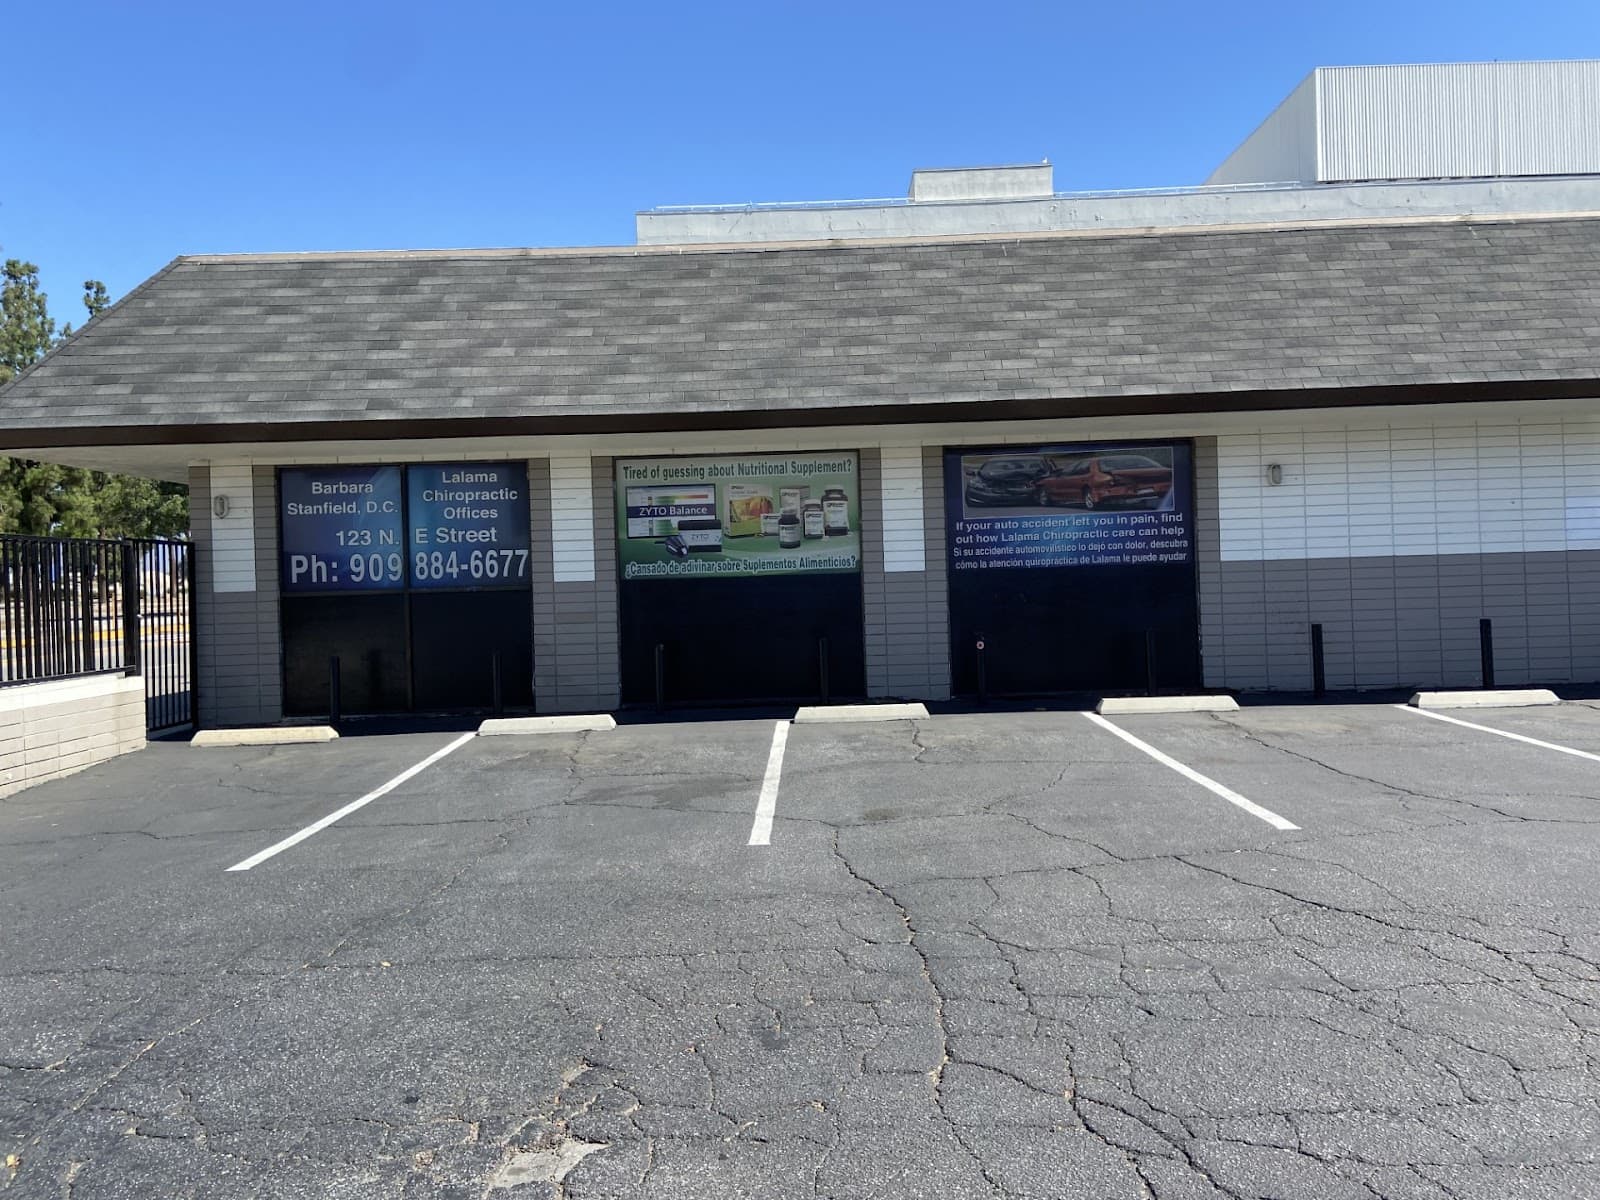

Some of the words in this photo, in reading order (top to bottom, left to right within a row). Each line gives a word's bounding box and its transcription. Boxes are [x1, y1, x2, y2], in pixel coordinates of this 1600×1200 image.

[442, 471, 497, 483] Lalama
[623, 465, 647, 479] Tired
[650, 465, 660, 478] of
[663, 464, 705, 480] guessing
[708, 464, 734, 476] about
[737, 461, 788, 476] Nutritional
[791, 459, 852, 476] Supplement?
[312, 481, 374, 495] Barbara
[422, 488, 518, 503] Chiropractic
[287, 502, 361, 516] Stanfield,
[366, 501, 399, 513] D.C.
[443, 506, 498, 520] Offices
[639, 507, 666, 516] ZYTO
[669, 506, 708, 516] Balance
[956, 521, 964, 531] If
[966, 522, 991, 532] your
[994, 520, 1019, 530] auto
[1021, 518, 1069, 528] accident
[1072, 516, 1090, 526] left
[1093, 517, 1114, 527] you
[1117, 515, 1128, 525] in
[1131, 514, 1158, 525] pain,
[1161, 513, 1183, 522] find
[336, 530, 372, 546] 123
[379, 529, 400, 545] N.
[415, 528, 428, 544] E
[435, 526, 497, 543] Street
[955, 535, 973, 544] out
[975, 534, 998, 543] how
[1001, 532, 1040, 542] Lalama
[1043, 530, 1109, 541] Chiropractic
[1112, 529, 1136, 537] care
[1139, 528, 1158, 536] can
[1161, 526, 1184, 536] help
[953, 547, 962, 557] Si
[963, 548, 974, 556] su
[975, 546, 1013, 556] accidente
[1078, 543, 1087, 551] lo
[1108, 542, 1123, 550] con
[1125, 540, 1149, 550] dolor,
[1150, 539, 1188, 549] descubra
[290, 554, 338, 584] Ph:
[350, 552, 401, 582] 909
[415, 549, 529, 580] 884-6677
[668, 561, 680, 574] de
[681, 560, 715, 573] adivinar
[717, 559, 740, 572] sobre
[743, 558, 797, 573] Suplementos
[800, 555, 856, 568] Alimenticios?
[979, 559, 988, 568] la
[1080, 555, 1090, 565] de
[1091, 554, 1121, 564] Lalama
[1122, 553, 1130, 562] le
[1132, 552, 1158, 563] puede
[1159, 552, 1187, 562] ayudar
